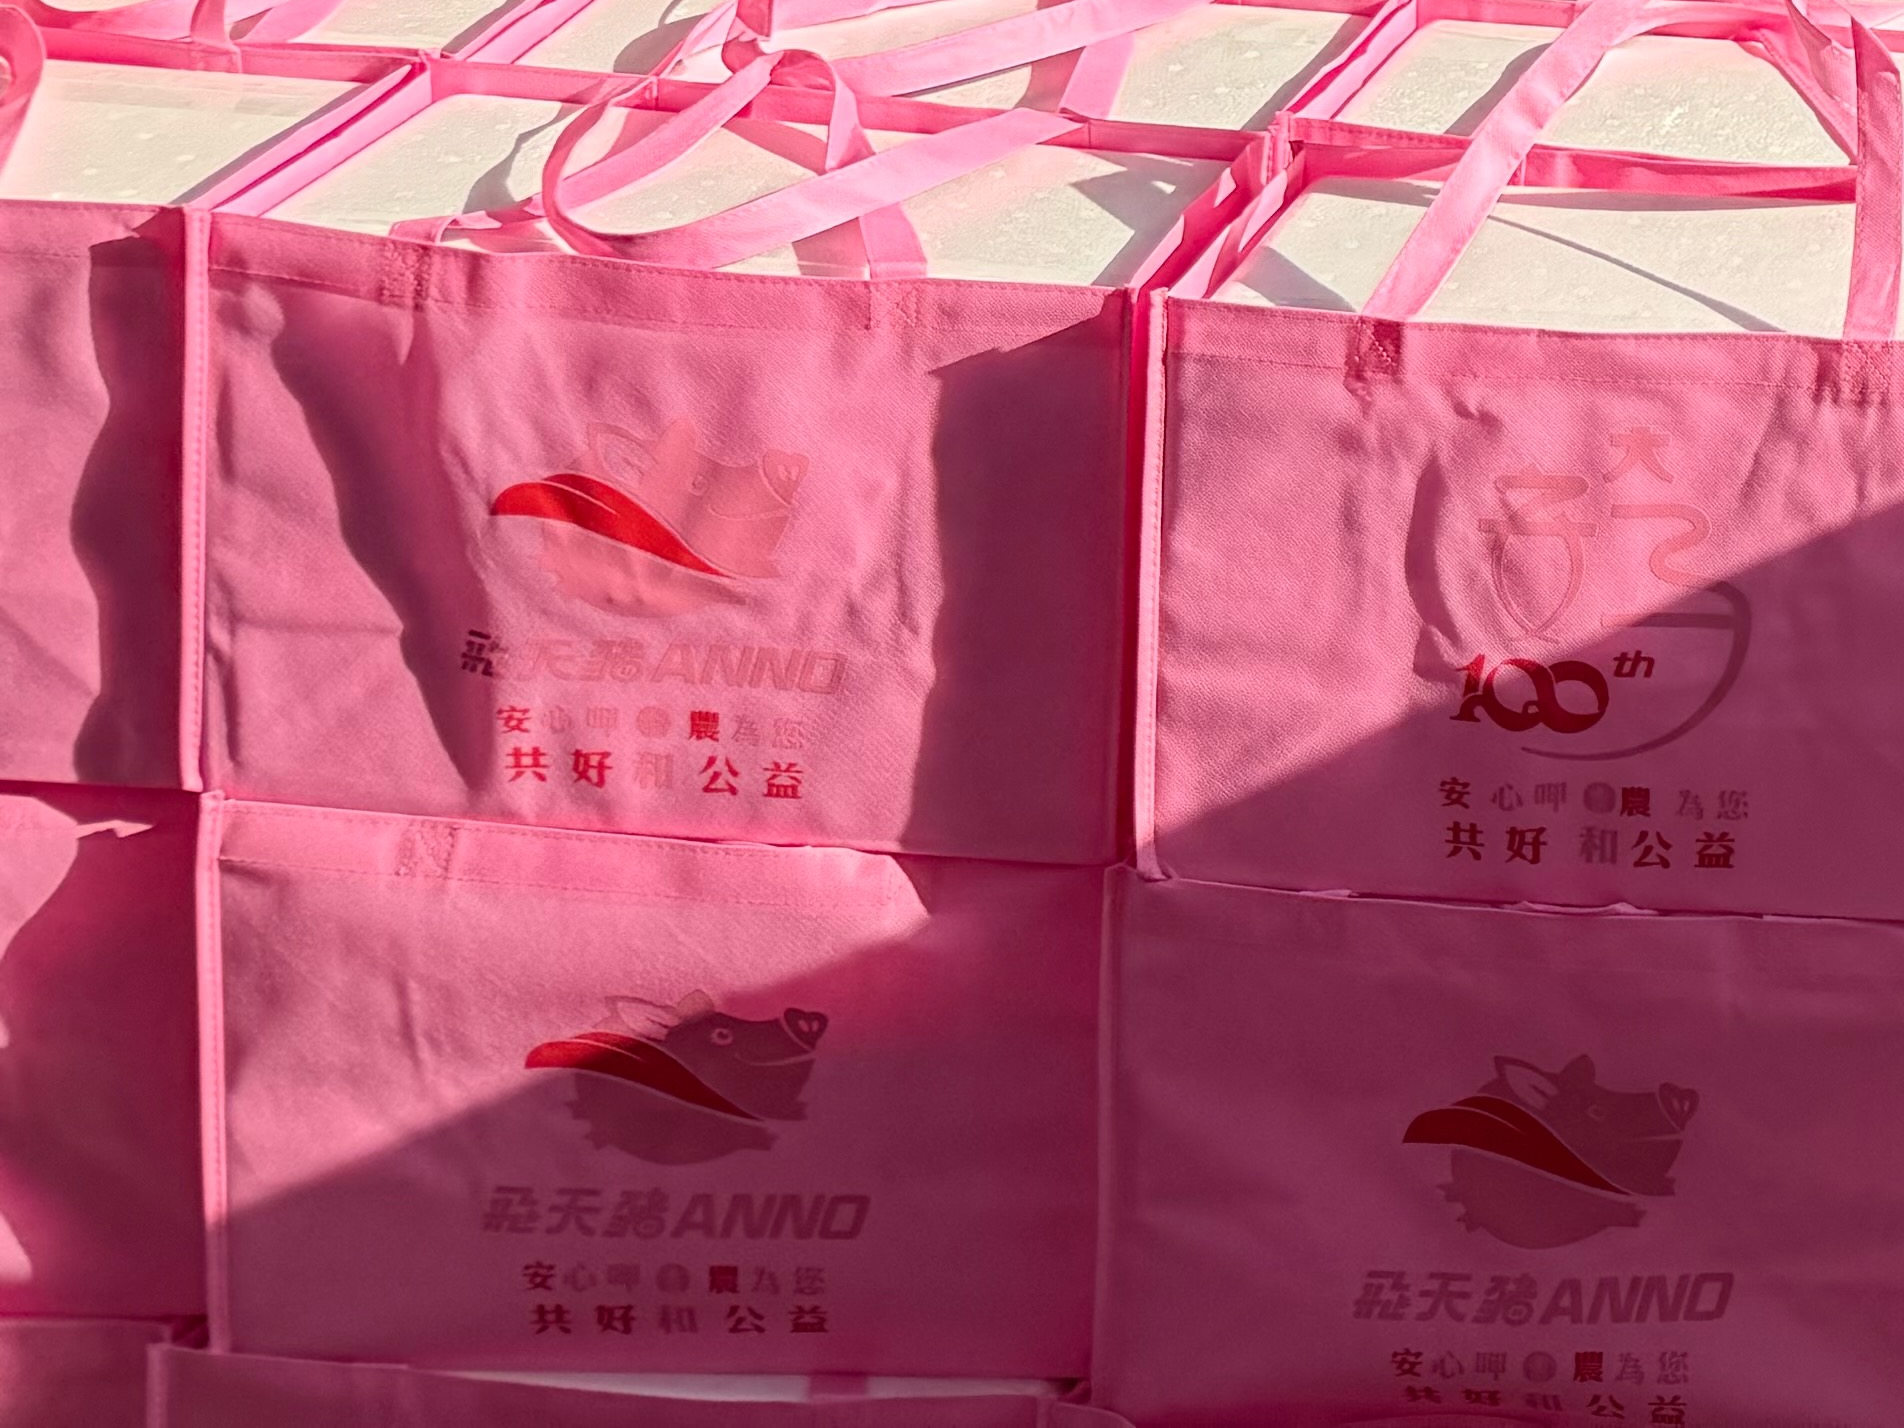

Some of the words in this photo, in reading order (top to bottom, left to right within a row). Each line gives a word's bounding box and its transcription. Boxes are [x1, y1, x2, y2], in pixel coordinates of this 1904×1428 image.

[1444, 821, 1735, 870] 共好和公益
